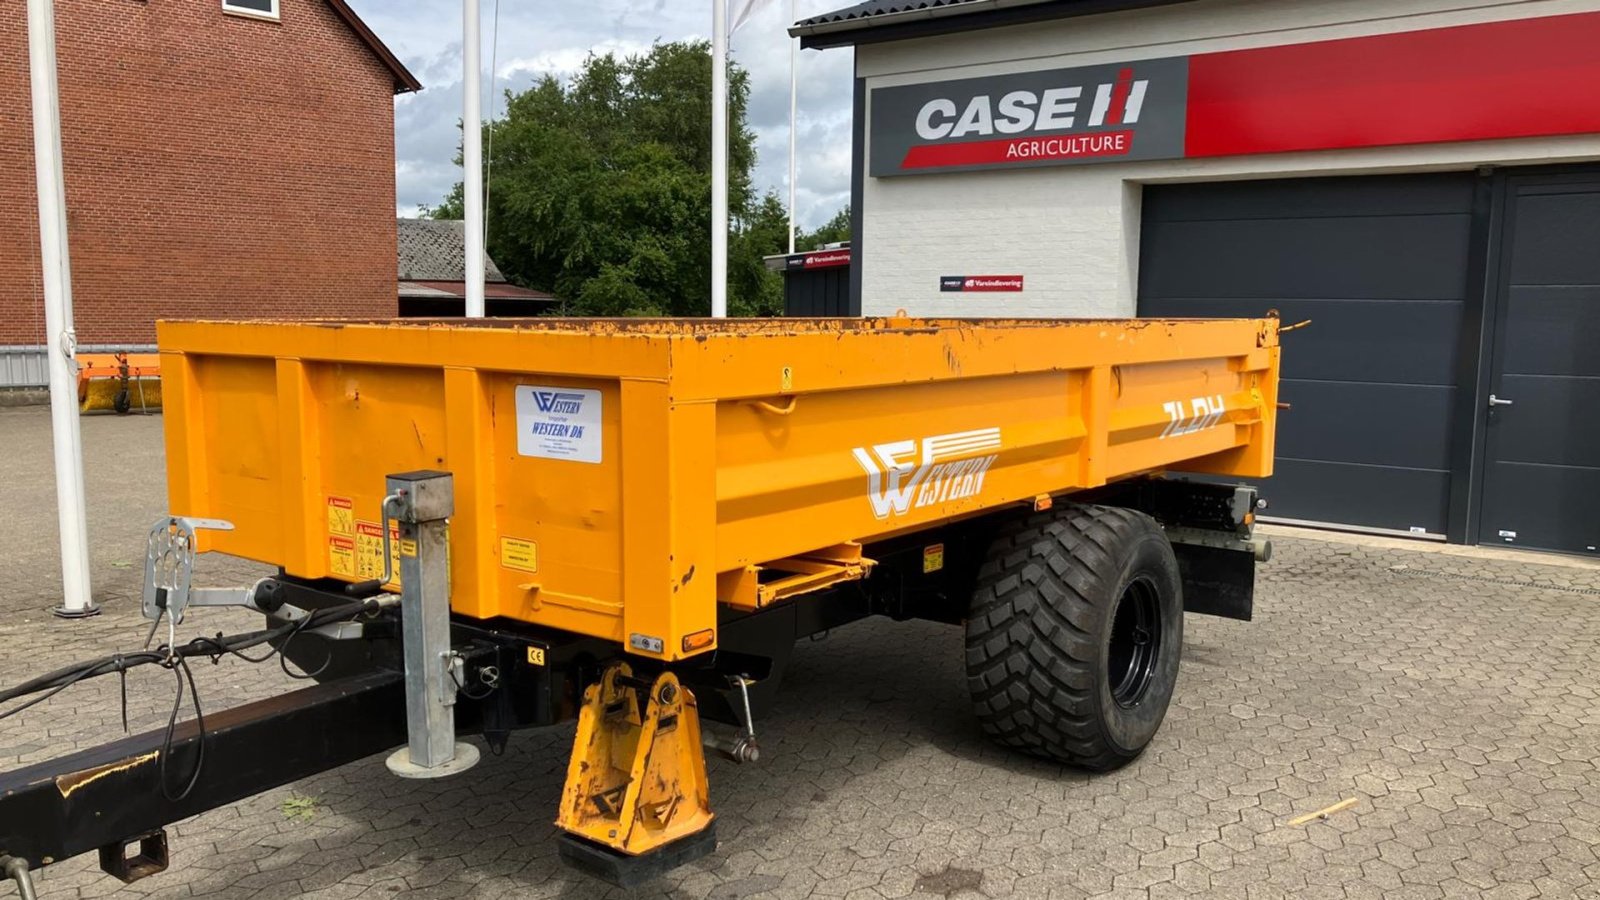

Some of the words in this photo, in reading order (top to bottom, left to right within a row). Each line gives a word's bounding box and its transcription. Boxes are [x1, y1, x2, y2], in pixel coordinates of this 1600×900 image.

[915, 86, 1083, 141] CASE
[1006, 135, 1124, 158] AGRICULTURE
[532, 391, 586, 414] WESTERN
[532, 422, 570, 437] WESTERN
[570, 425, 584, 439] DK
[852, 427, 1001, 520] WESTERN
[530, 649, 542, 662] CE
